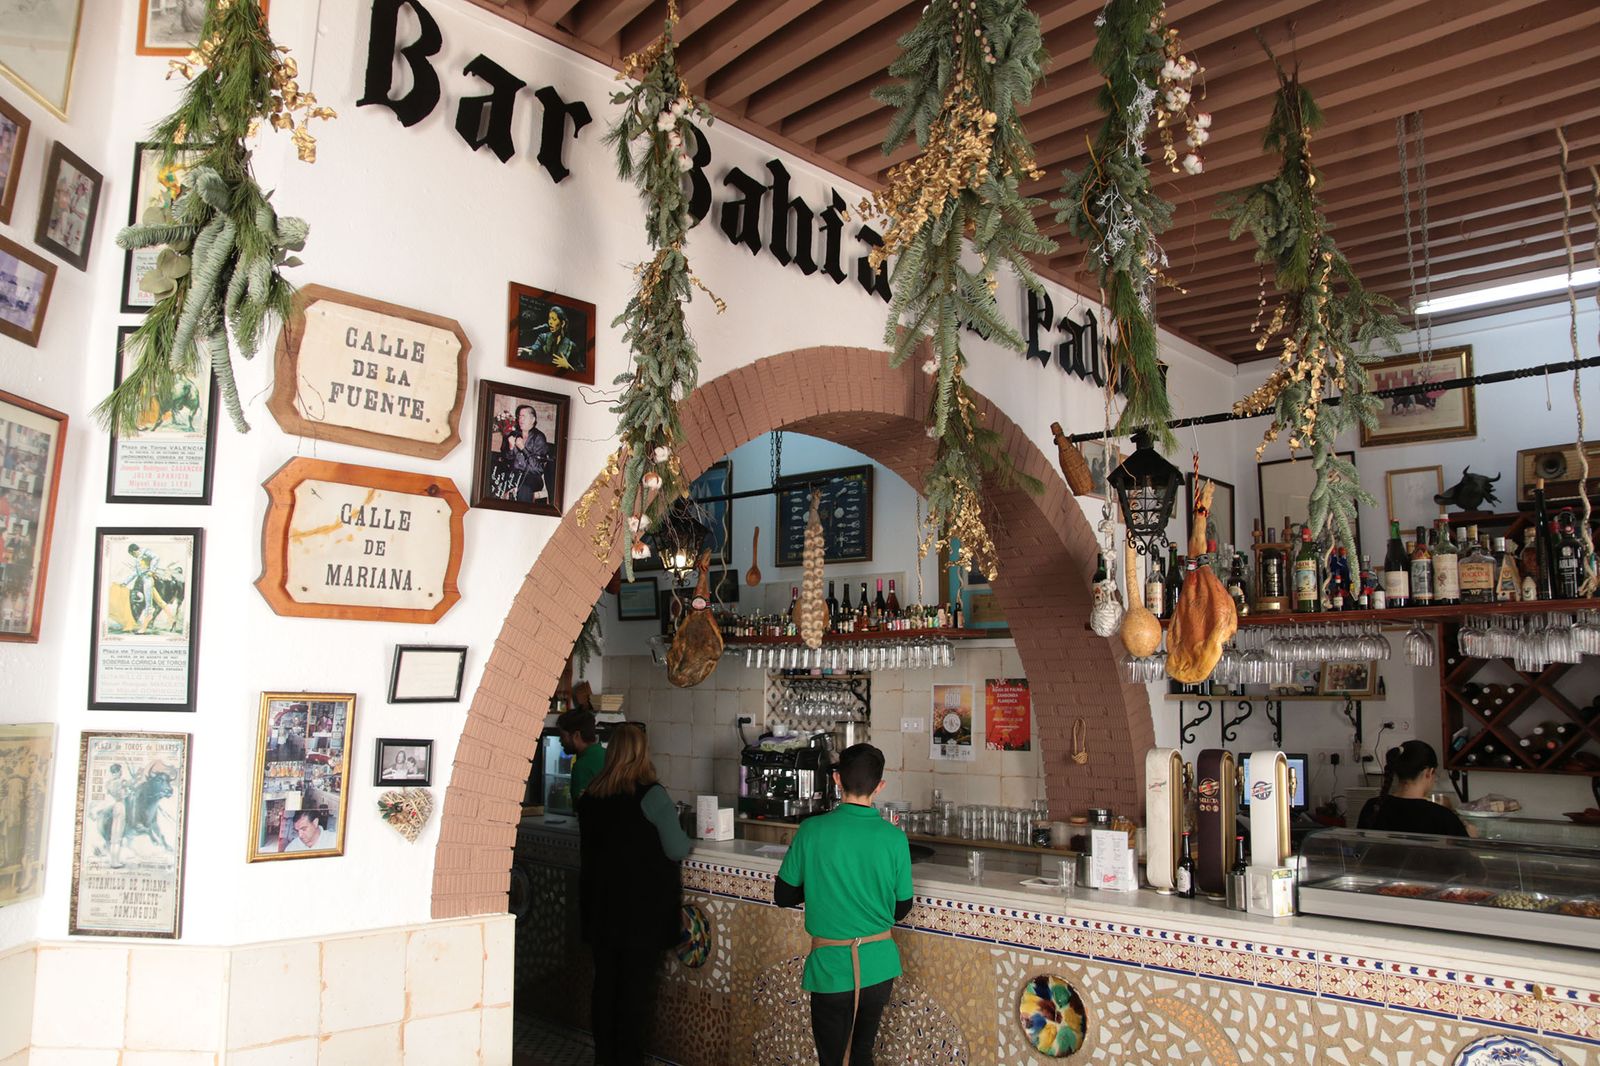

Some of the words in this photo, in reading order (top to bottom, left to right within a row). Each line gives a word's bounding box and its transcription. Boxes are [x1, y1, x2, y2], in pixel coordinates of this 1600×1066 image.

[356, 0, 592, 184] Bar
[345, 326, 425, 364] CALLE
[352, 359, 378, 380] DE
[385, 366, 411, 387] LA
[328, 381, 431, 423] FUENTE.
[341, 503, 411, 531] CALLE
[363, 539, 386, 556] DE
[325, 564, 422, 591] MARIANA.
[125, 743, 143, 751] TOROS
